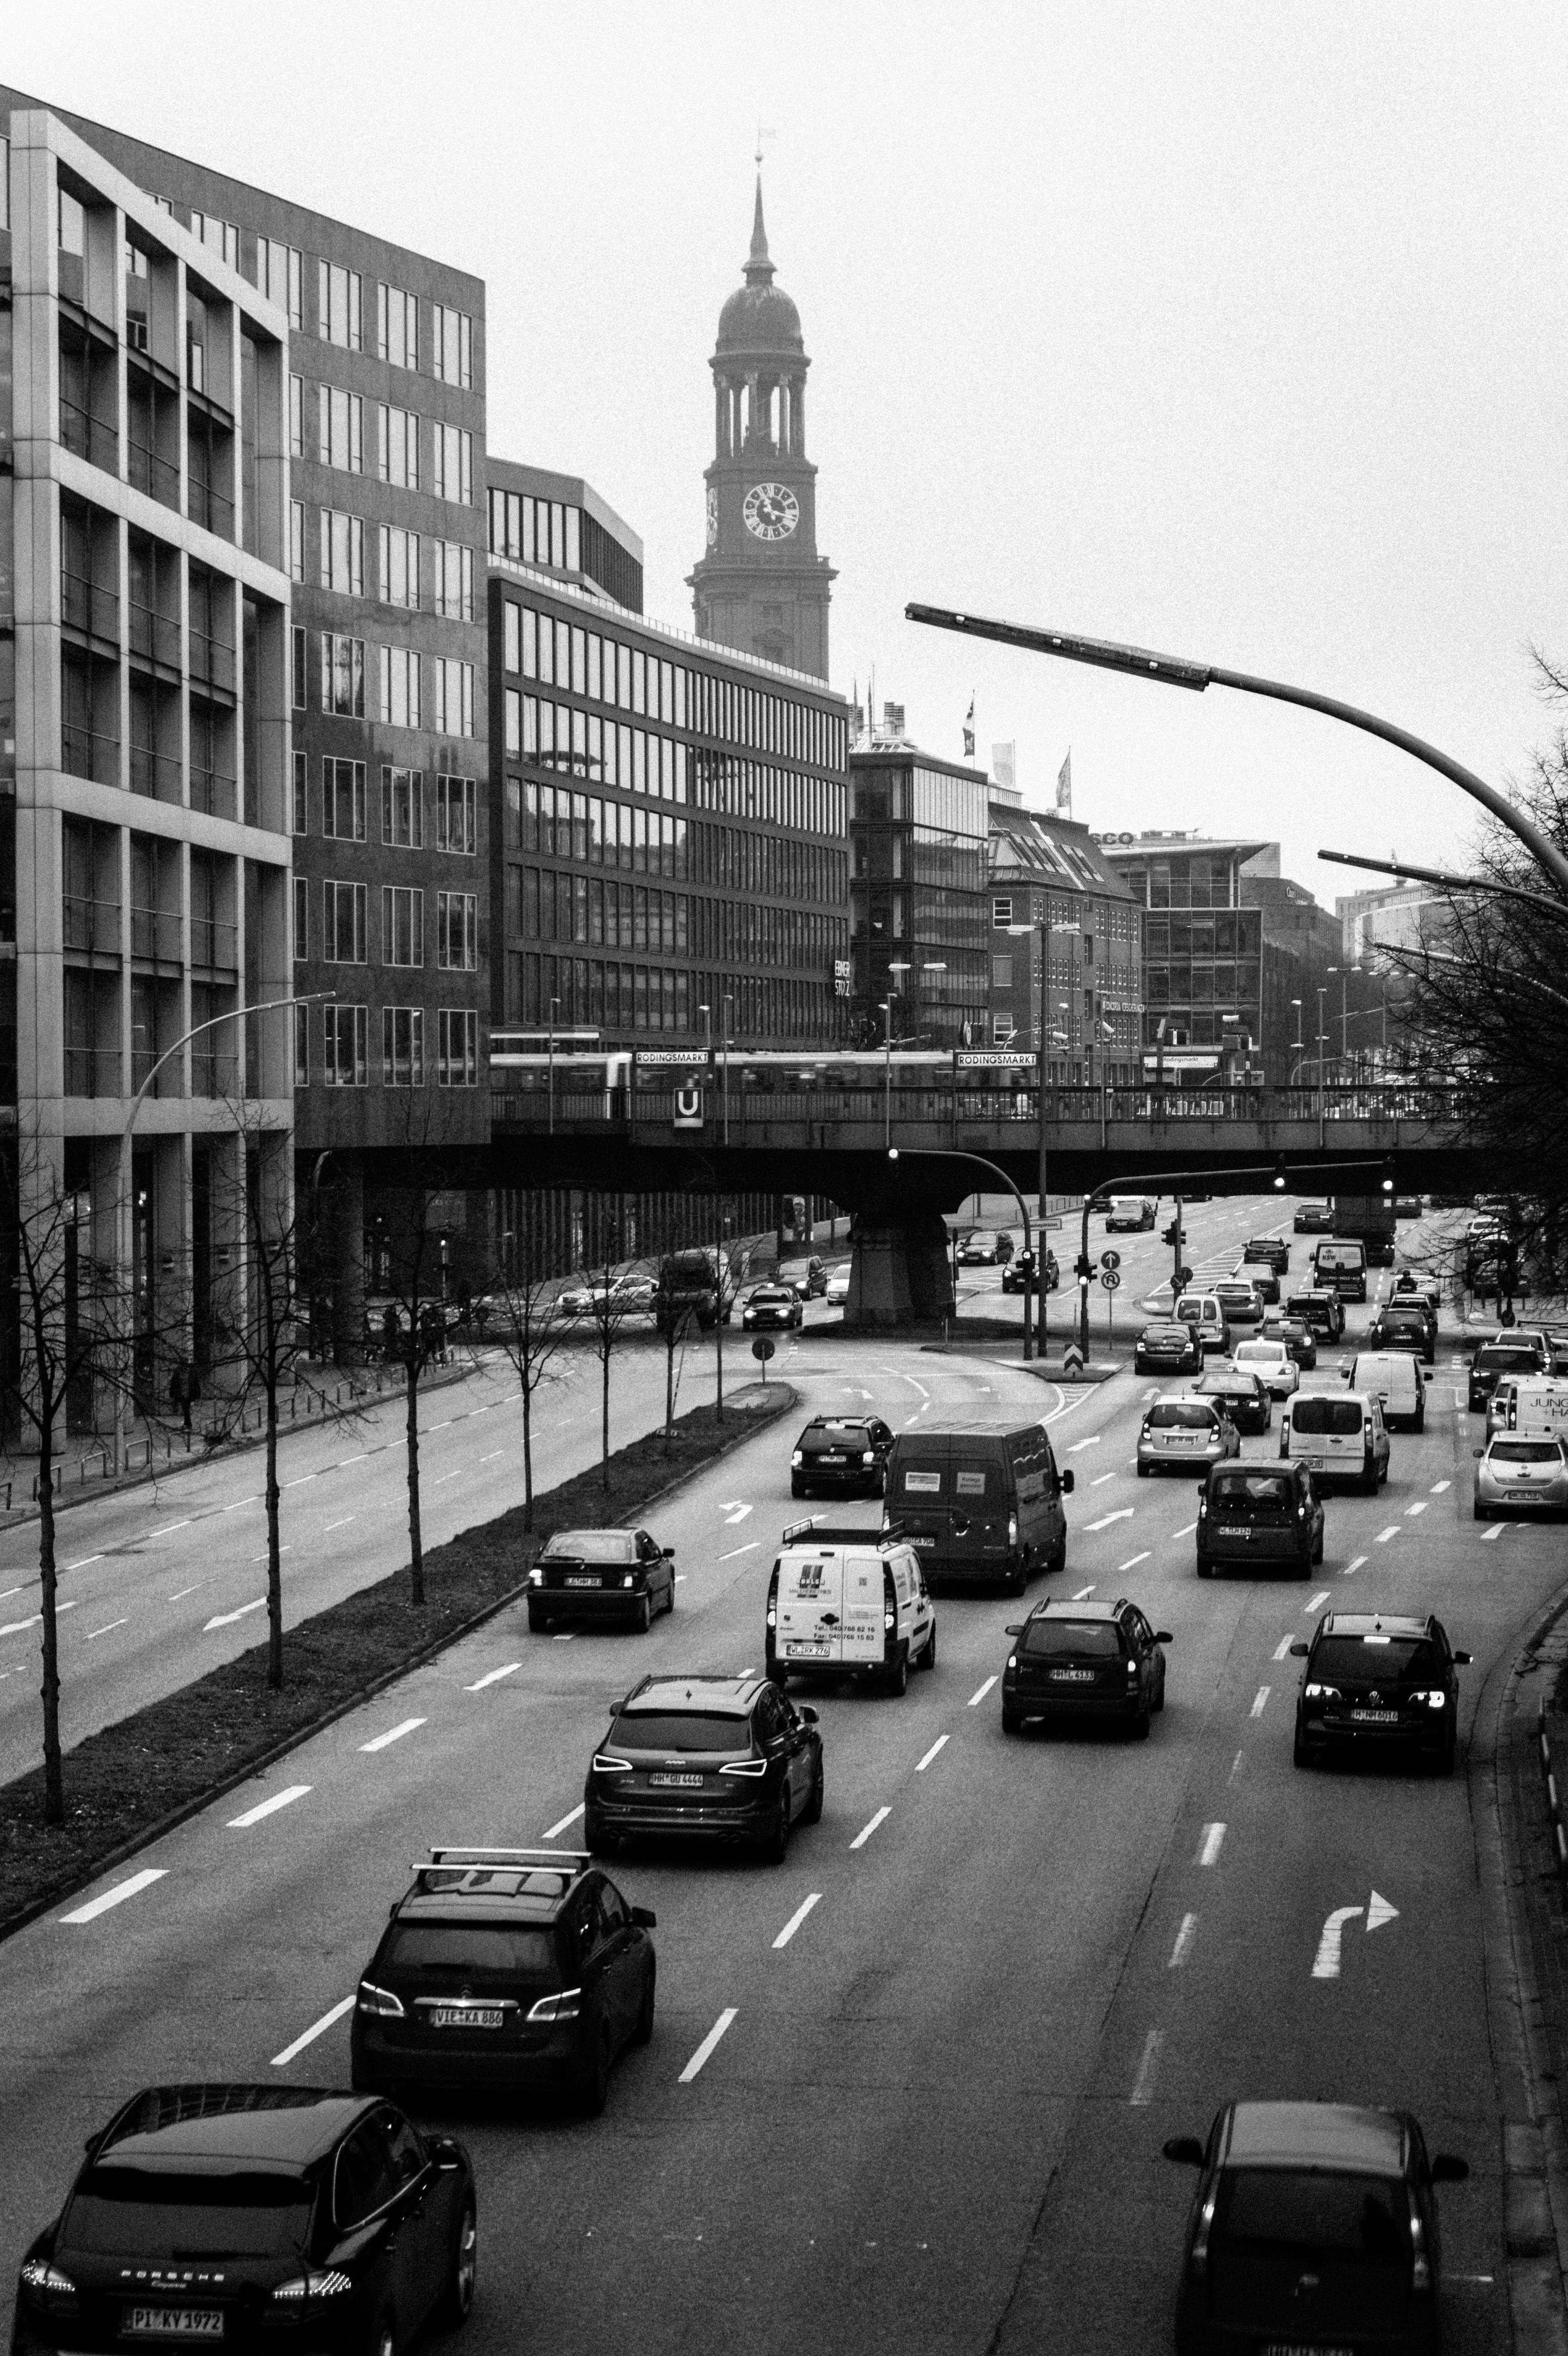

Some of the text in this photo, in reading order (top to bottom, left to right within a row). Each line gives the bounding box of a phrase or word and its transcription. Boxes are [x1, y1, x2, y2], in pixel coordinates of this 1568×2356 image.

[679, 1091, 698, 1116] U
[121, 2269, 225, 2282] PORSCHE
[135, 2310, 221, 2330] PI KY 1972
